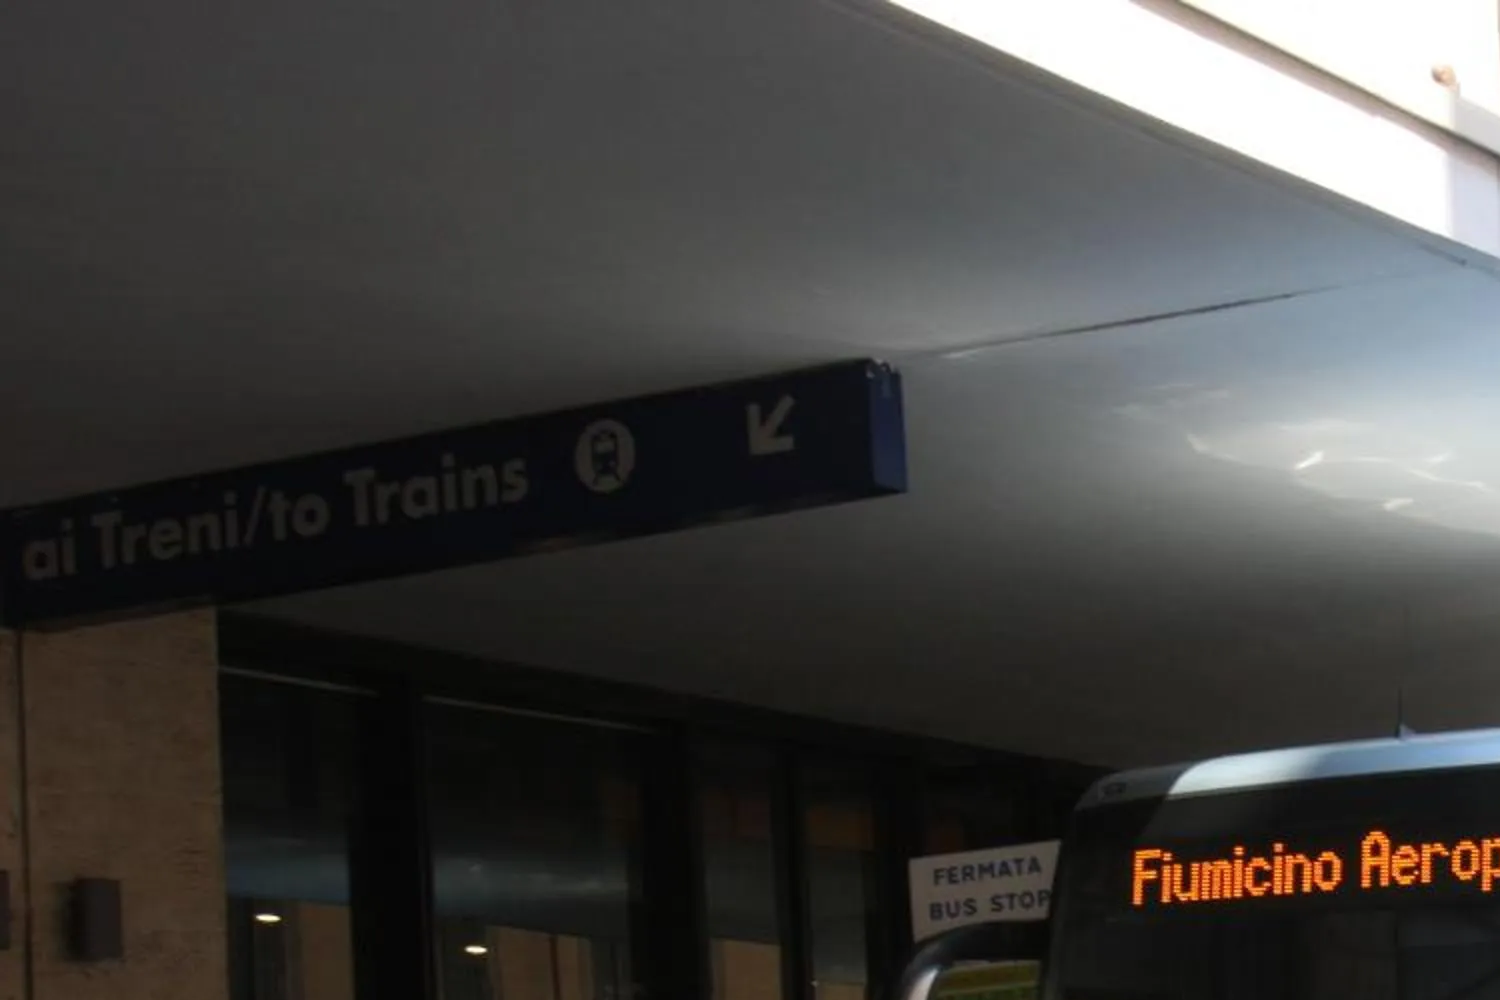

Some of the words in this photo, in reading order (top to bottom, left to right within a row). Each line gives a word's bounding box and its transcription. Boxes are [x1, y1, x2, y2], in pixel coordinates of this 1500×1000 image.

[22, 518, 78, 582] ai
[93, 484, 330, 571] Treni/to
[343, 449, 530, 530] Trains
[933, 856, 1043, 886] FERMATA
[1131, 843, 1343, 905] Fiumicino
[929, 898, 977, 921] BUS
[990, 889, 1052, 913] STOP
